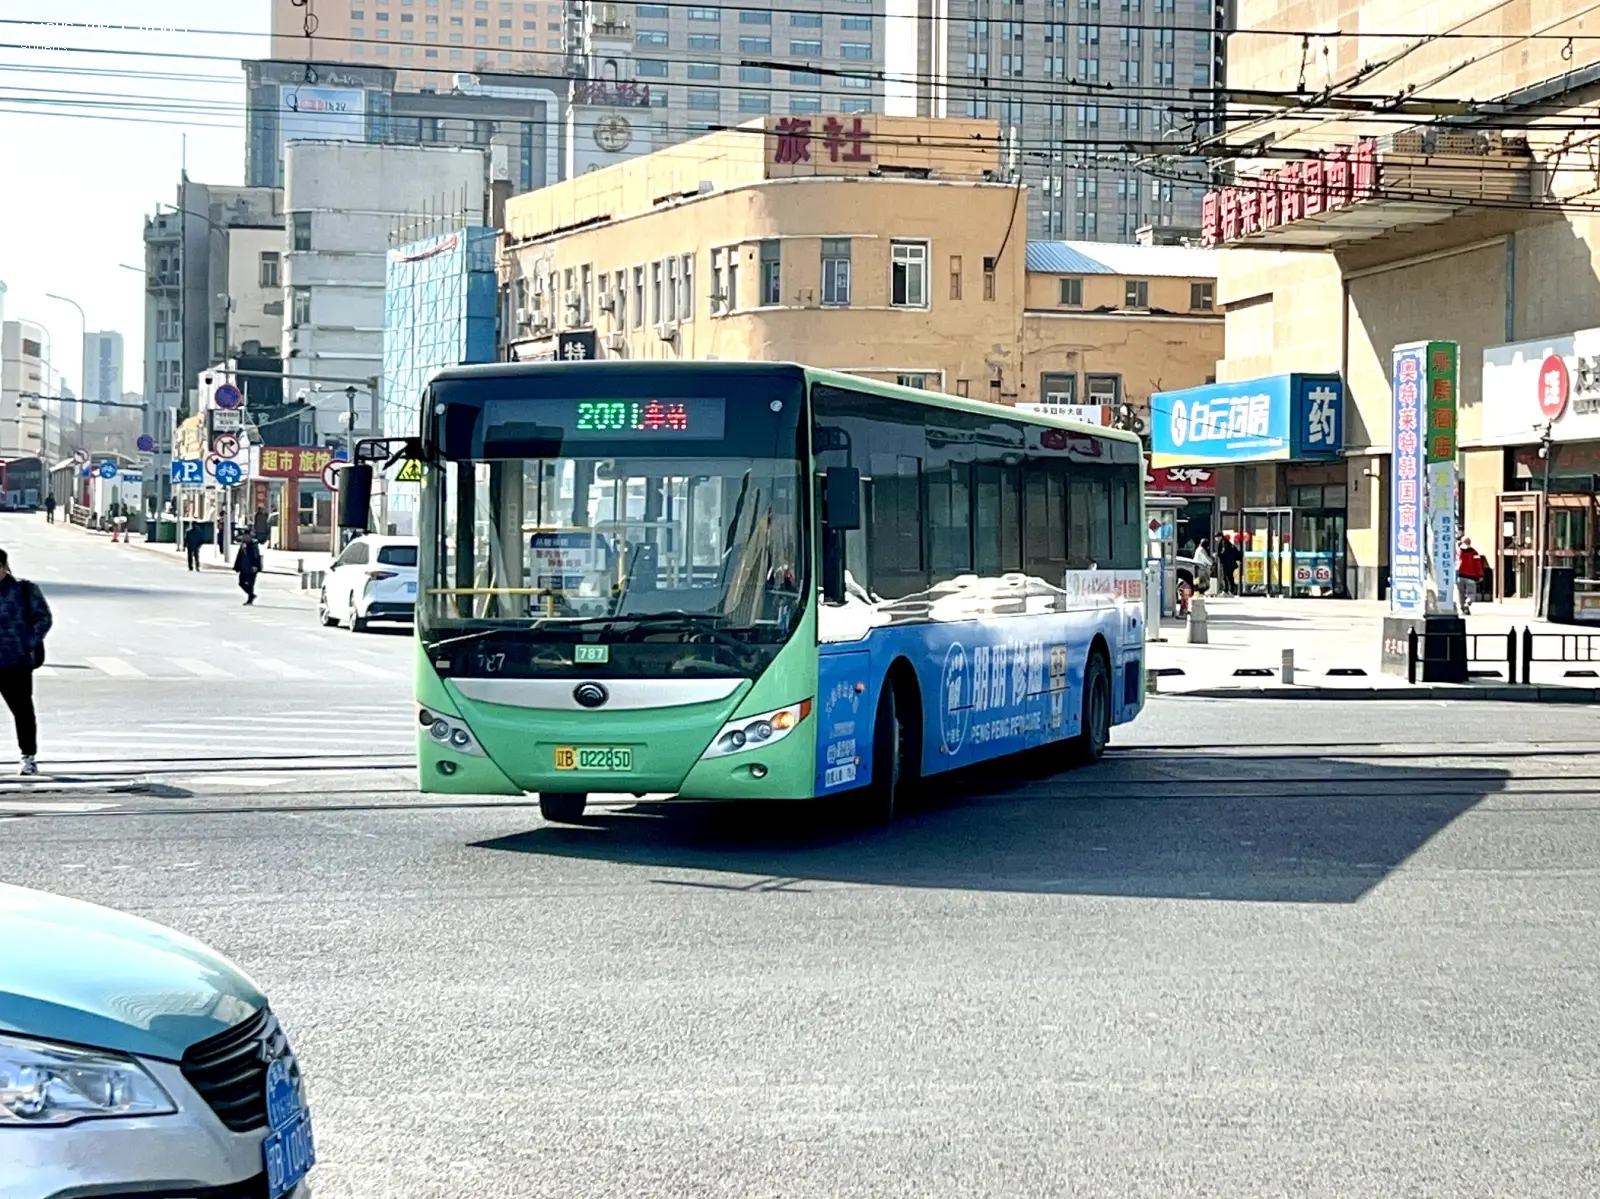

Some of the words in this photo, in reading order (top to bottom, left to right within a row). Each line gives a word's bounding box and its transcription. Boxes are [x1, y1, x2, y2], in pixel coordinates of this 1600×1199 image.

[775, 117, 871, 164] 旅社
[564, 341, 586, 360] 特
[1308, 386, 1337, 445] 药
[262, 450, 294, 472] 超市
[299, 450, 332, 472] 旅馆
[1399, 358, 1418, 552] 奥特莱特韩国商城
[182, 462, 198, 481] P
[579, 648, 605, 660] 787
